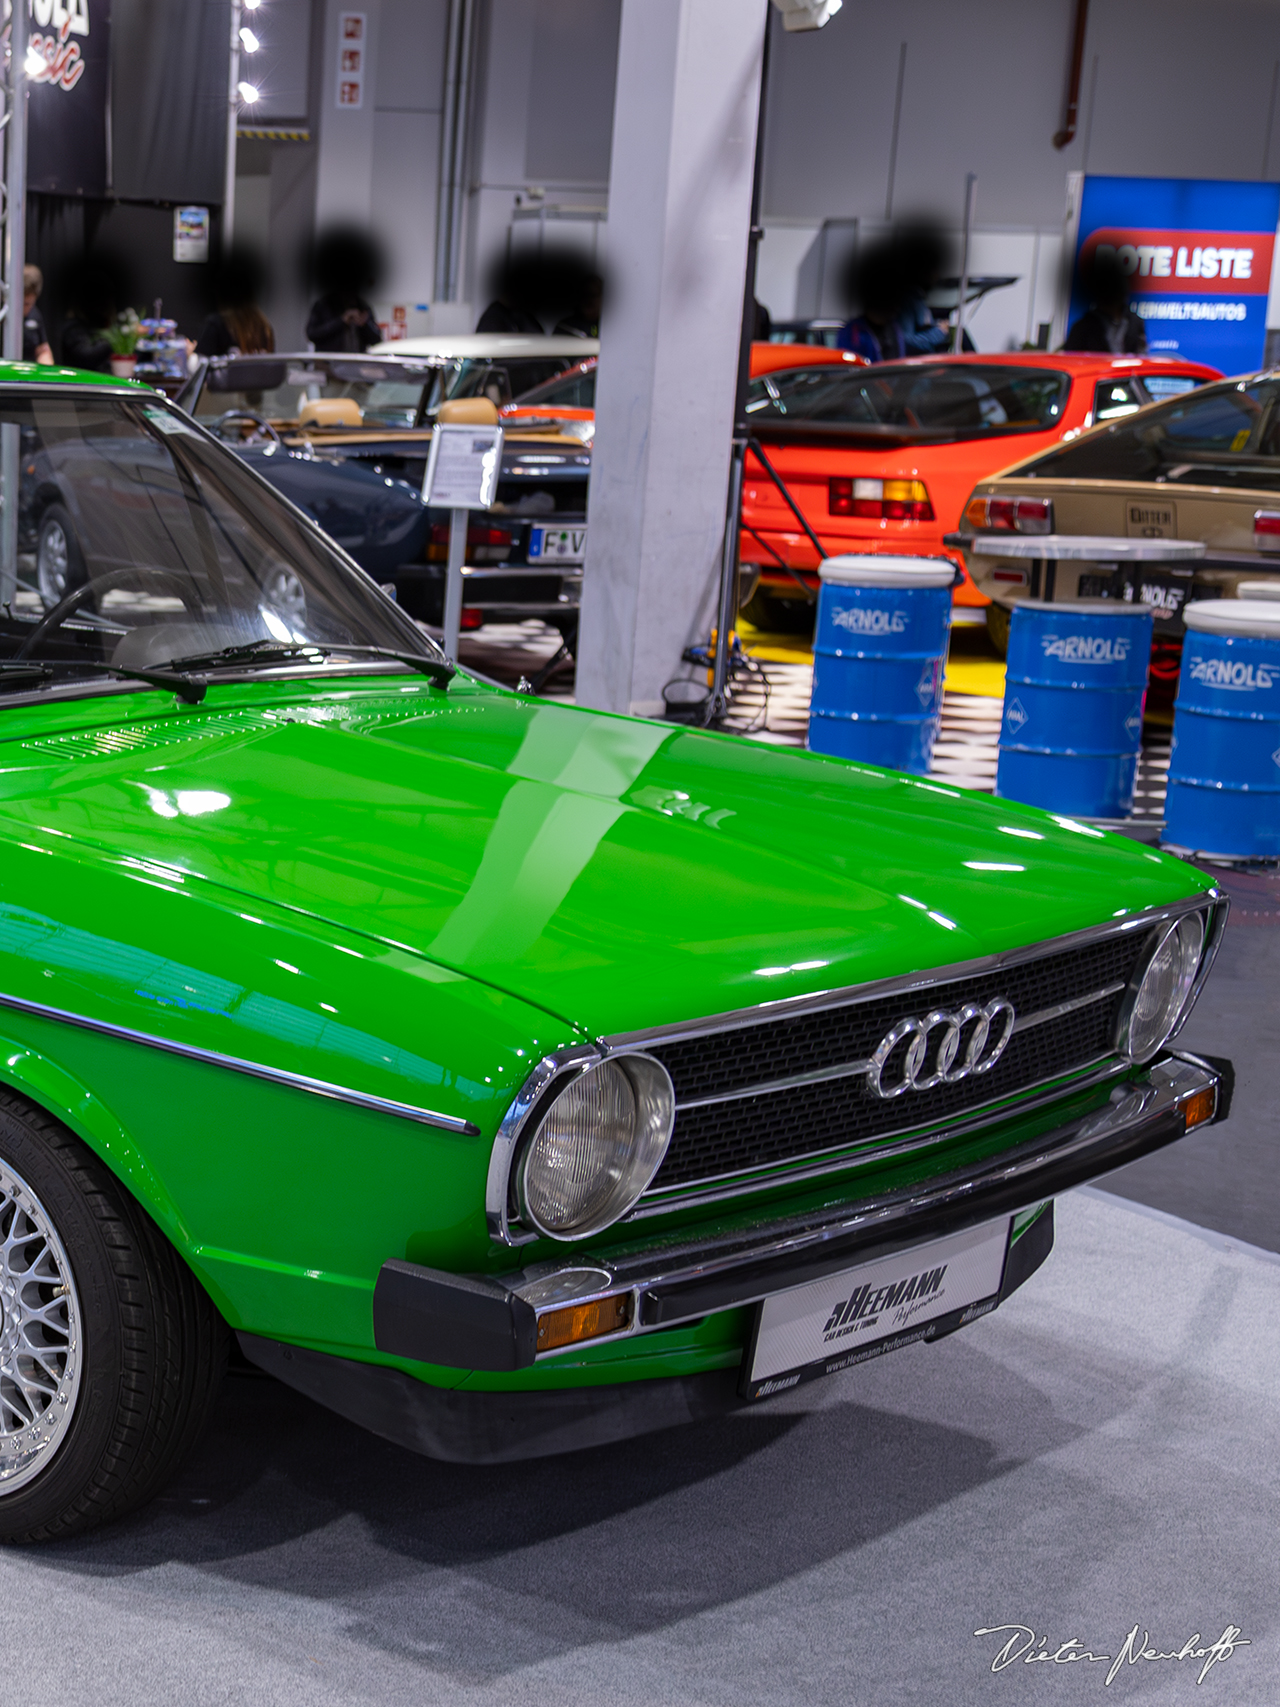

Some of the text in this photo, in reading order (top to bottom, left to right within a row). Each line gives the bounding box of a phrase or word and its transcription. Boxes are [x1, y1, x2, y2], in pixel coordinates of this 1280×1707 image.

[1175, 246, 1254, 279] LISTE
[832, 608, 906, 634] ARNOLD
[1043, 636, 1128, 662] ARNOLD
[1190, 658, 1273, 689] ARNOLD
[833, 1264, 948, 1327] HEEMANN
[891, 1289, 945, 1327] Performance
[825, 1325, 936, 1374] www.Heemann-Performance.de
